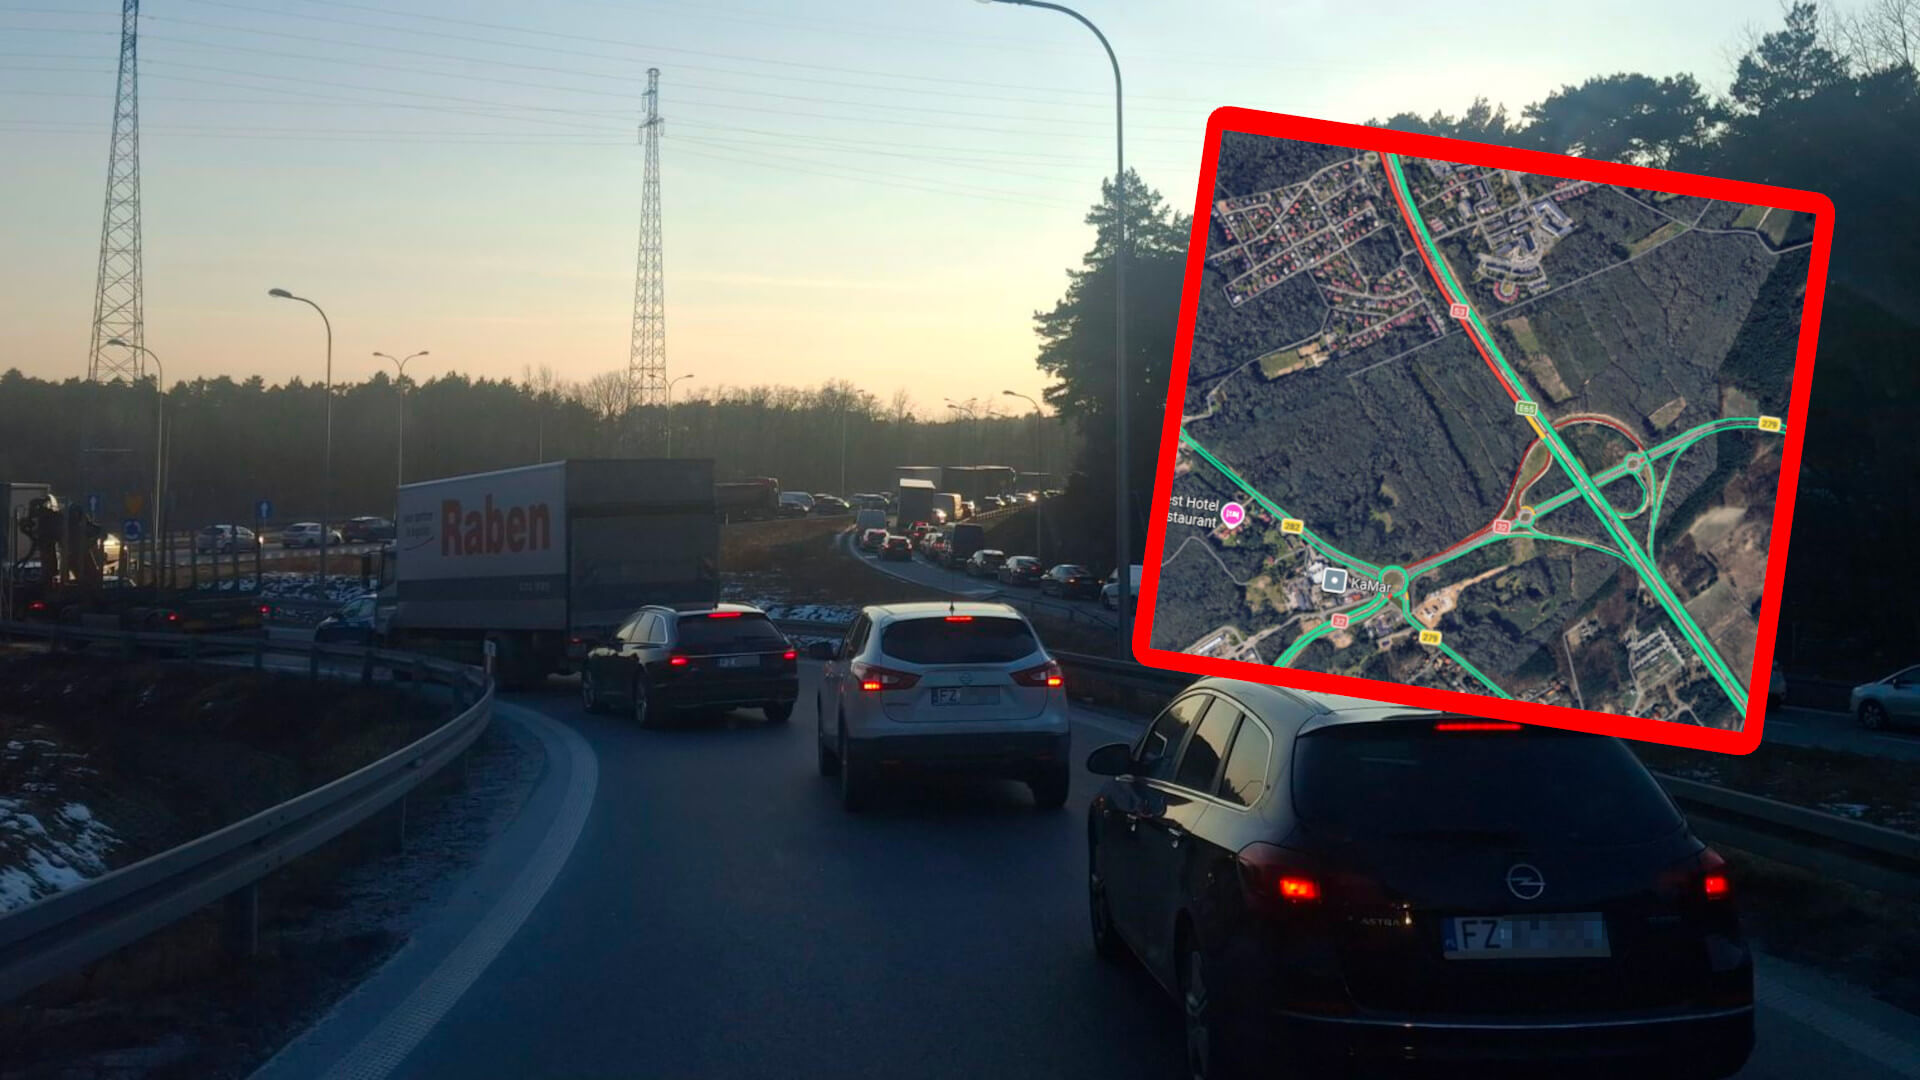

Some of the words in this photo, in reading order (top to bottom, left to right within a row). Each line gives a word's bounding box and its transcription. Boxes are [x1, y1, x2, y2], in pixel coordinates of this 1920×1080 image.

[441, 494, 550, 557] Raben
[940, 688, 957, 703] FZ
[1462, 920, 1500, 949] FZ
